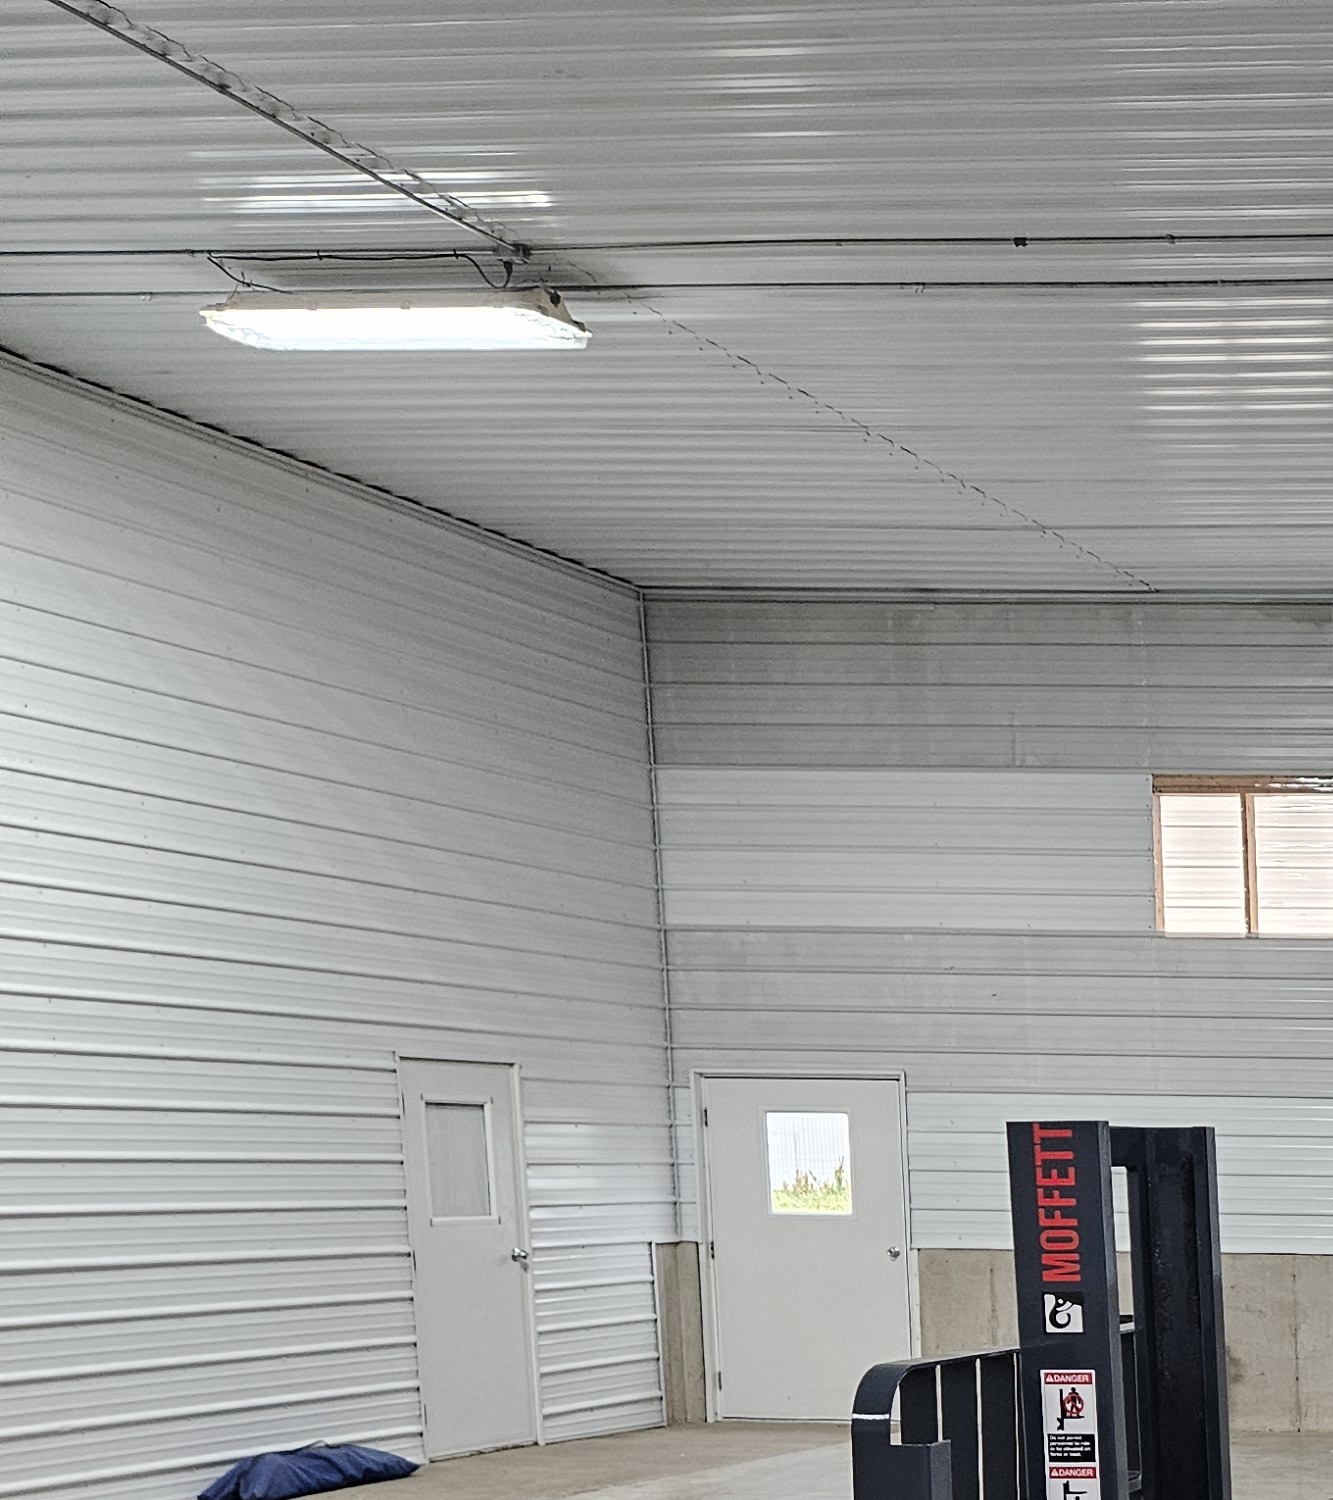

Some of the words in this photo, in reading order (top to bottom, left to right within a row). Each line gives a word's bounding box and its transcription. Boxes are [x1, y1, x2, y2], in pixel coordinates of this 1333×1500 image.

[1033, 1123, 1081, 1282] MOFFETT
[1054, 1374, 1089, 1382] DANGER
[1058, 1469, 1093, 1477] DANGER
